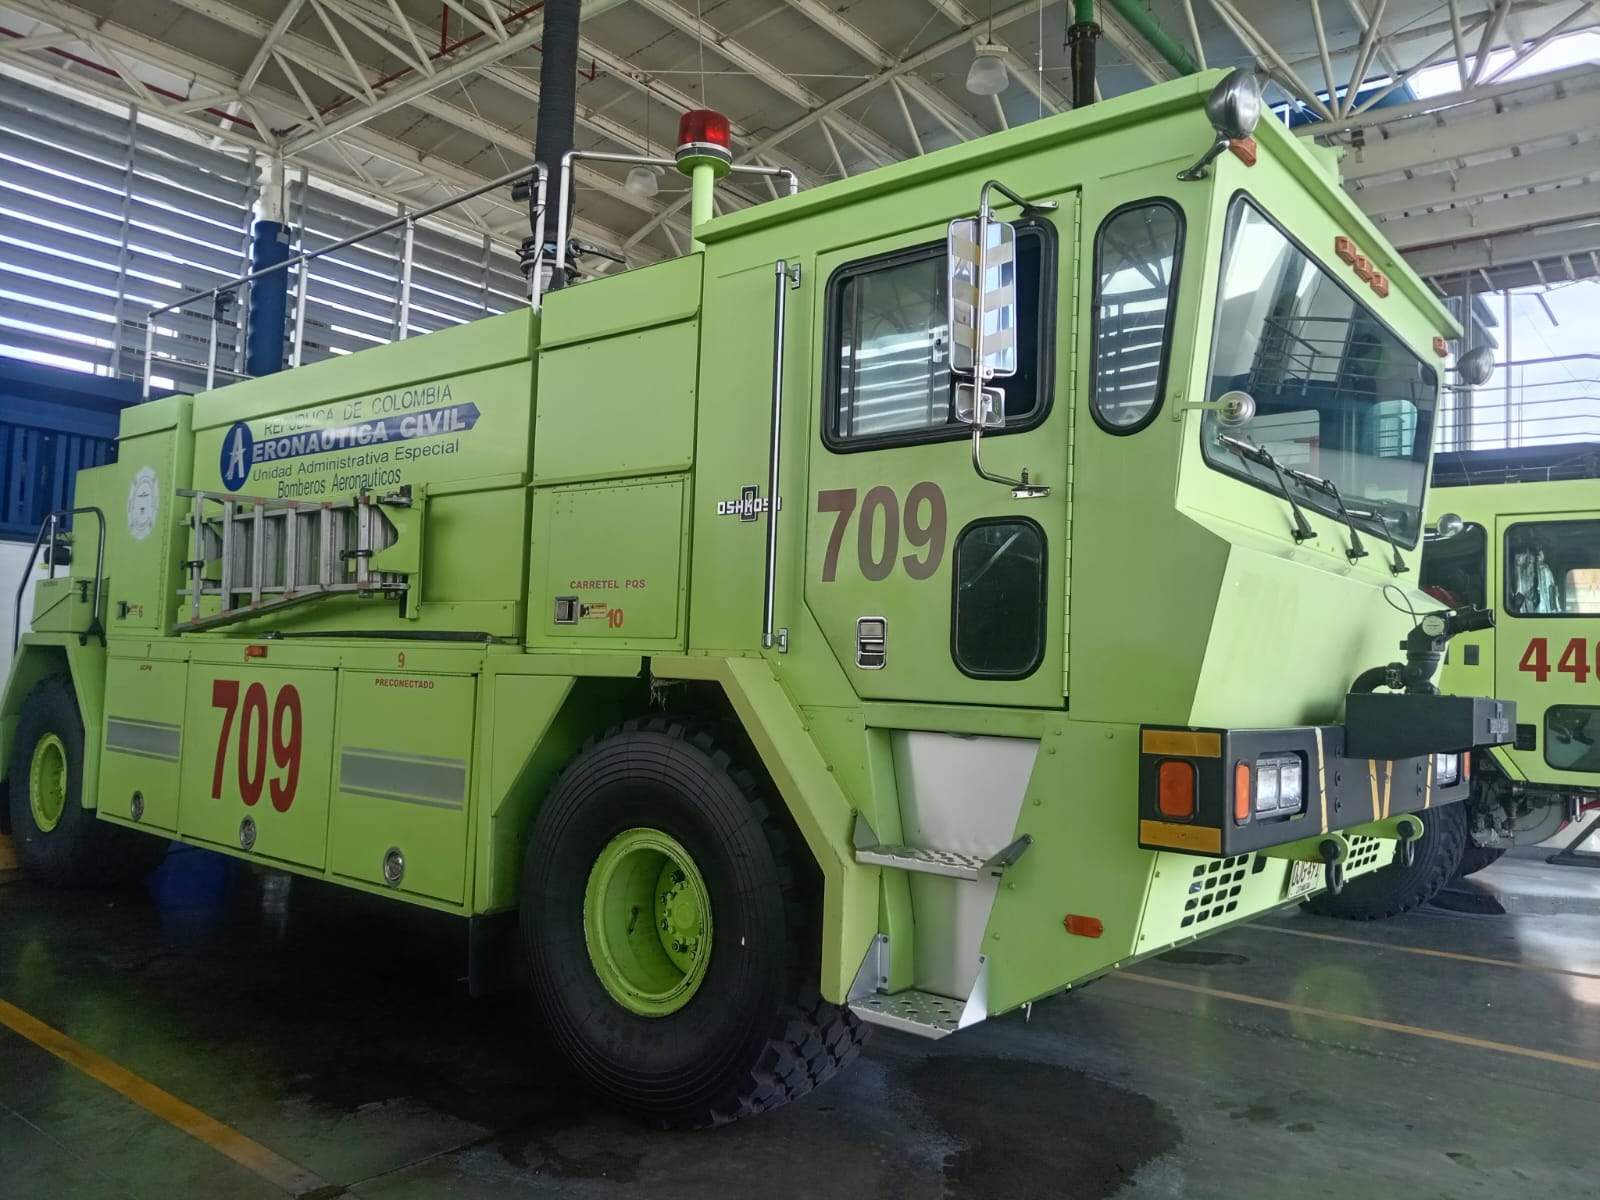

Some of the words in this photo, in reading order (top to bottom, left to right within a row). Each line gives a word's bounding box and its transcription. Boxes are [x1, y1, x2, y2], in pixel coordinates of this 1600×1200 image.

[344, 401, 362, 420] DE
[372, 384, 453, 415] COLOMBIA
[400, 408, 466, 438] CIVIL
[253, 464, 292, 482] Unidad
[298, 450, 389, 476] Administrativa
[395, 438, 459, 461] Especial
[278, 479, 326, 499] Bomberos
[332, 468, 401, 493] Aeronauticos
[817, 480, 948, 583] 709
[569, 580, 619, 590] CARRETEL
[625, 579, 646, 589] PQS
[607, 608, 624, 629] 10
[398, 651, 405, 668] 9
[1519, 637, 1600, 683] 44
[375, 678, 434, 690] PRECONECTADO
[211, 679, 303, 813] 709
